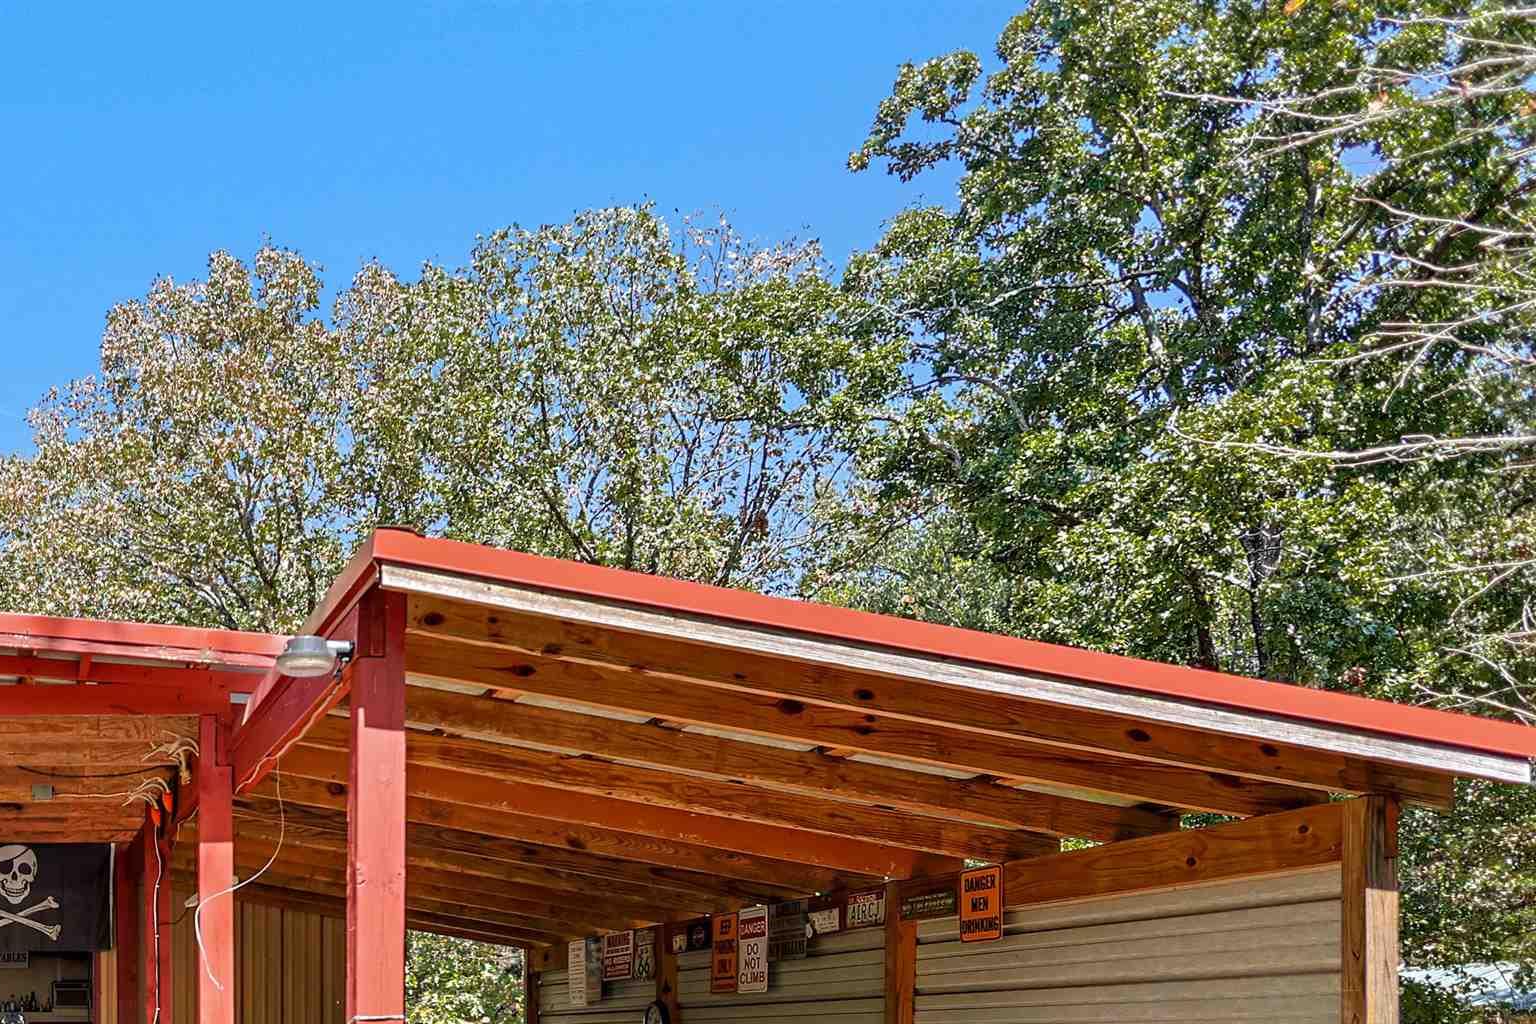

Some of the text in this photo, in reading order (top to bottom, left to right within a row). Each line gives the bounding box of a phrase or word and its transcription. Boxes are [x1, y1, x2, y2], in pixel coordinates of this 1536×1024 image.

[964, 874, 996, 893] DANGER
[971, 895, 990, 913] MEN
[739, 919, 766, 936] DANGER
[746, 942, 760, 956] DO
[744, 957, 761, 970] NOT
[739, 971, 765, 986] CLIMB
